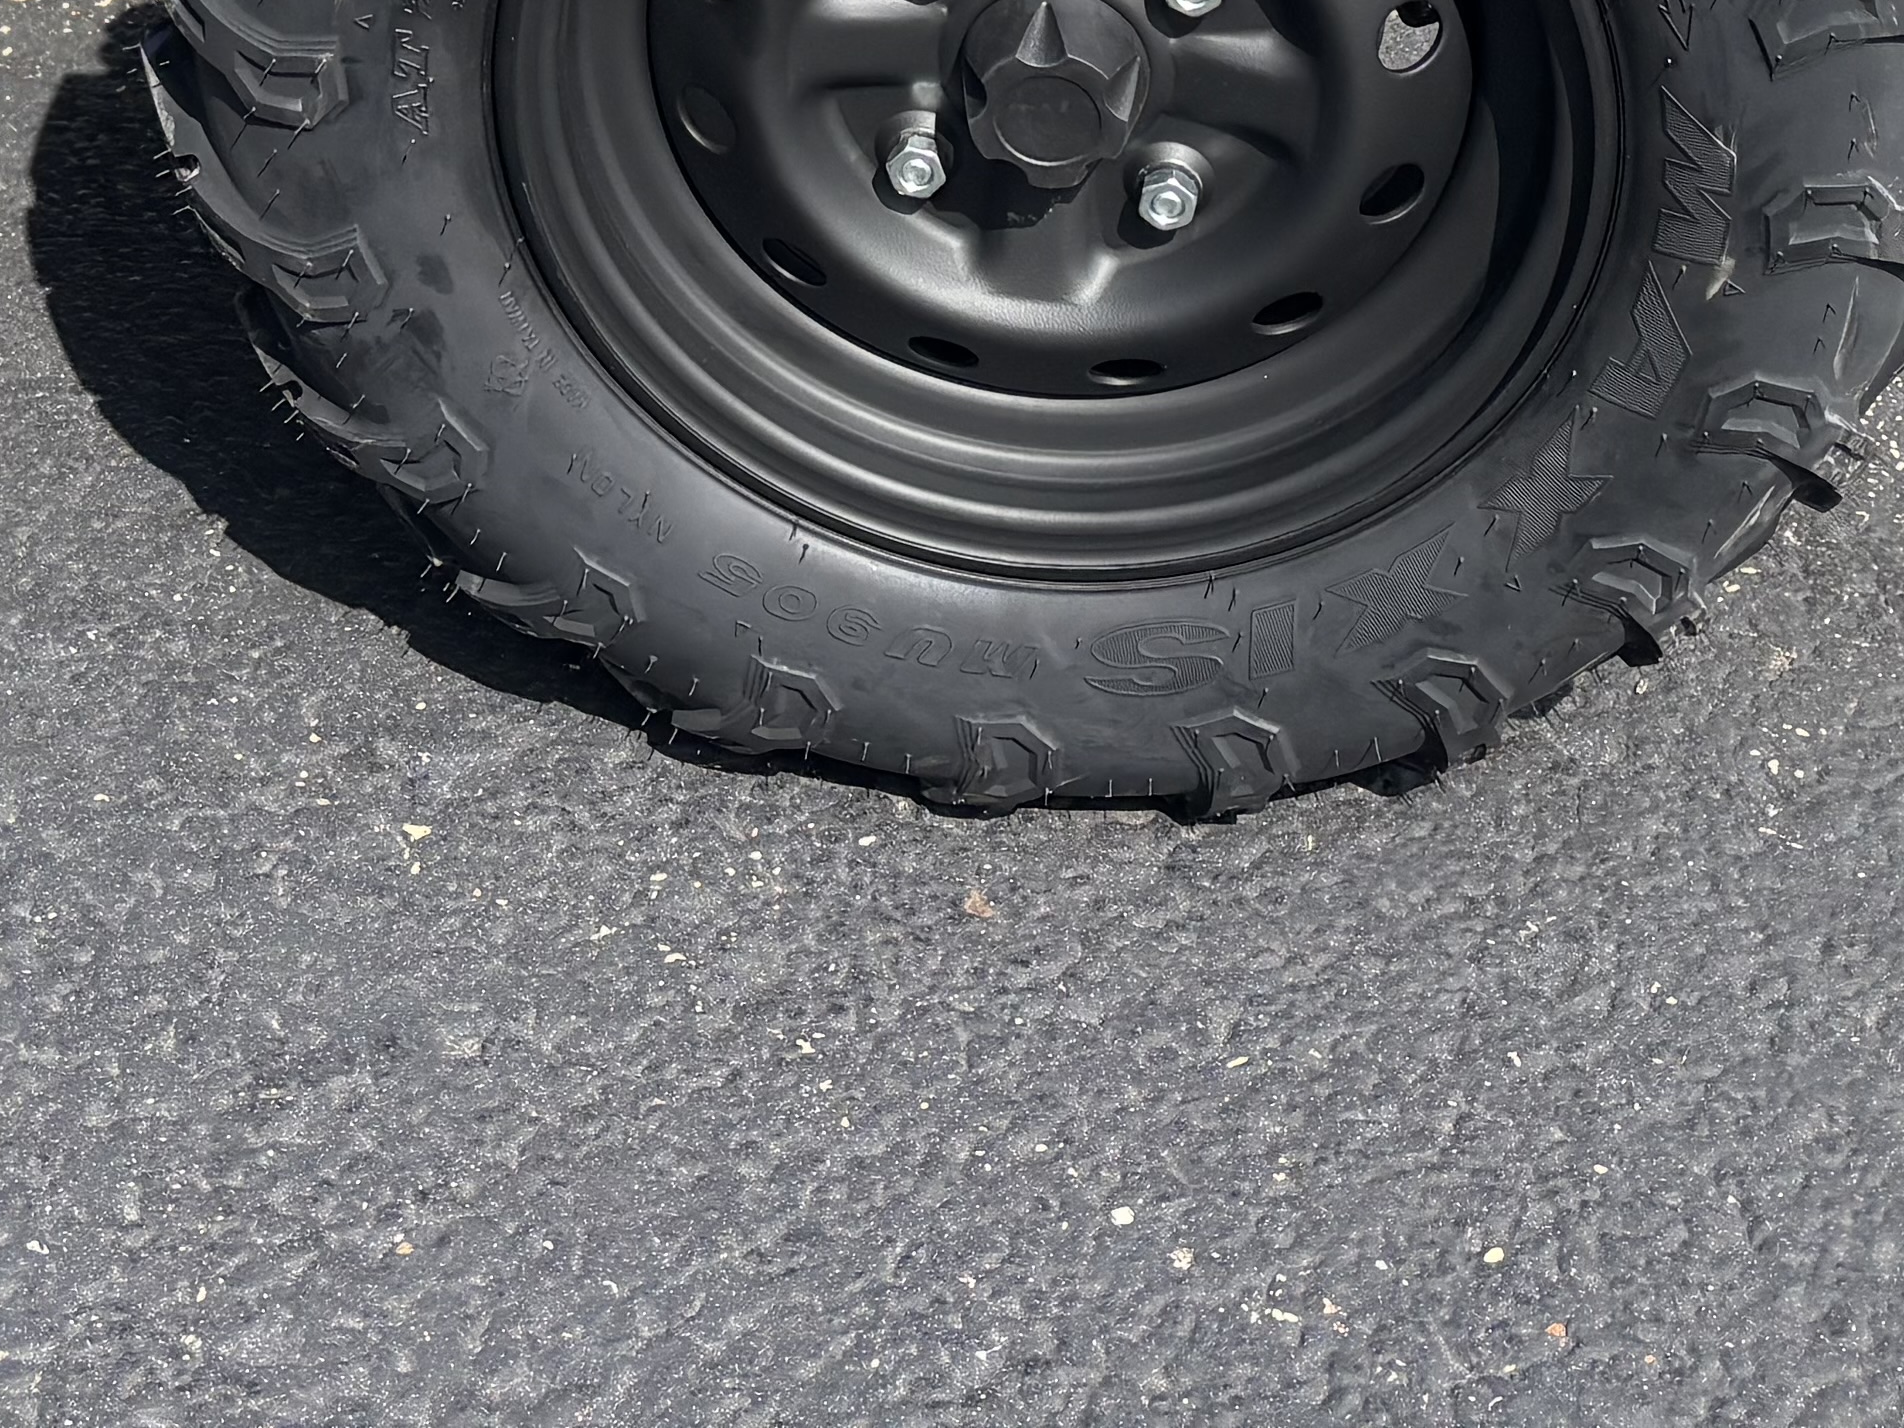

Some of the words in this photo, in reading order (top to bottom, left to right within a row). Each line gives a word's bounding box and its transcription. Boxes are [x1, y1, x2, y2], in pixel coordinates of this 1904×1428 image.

[1083, 85, 1737, 696] MAXXIS
[570, 447, 673, 544] NYLON
[698, 553, 1041, 680] MU905
